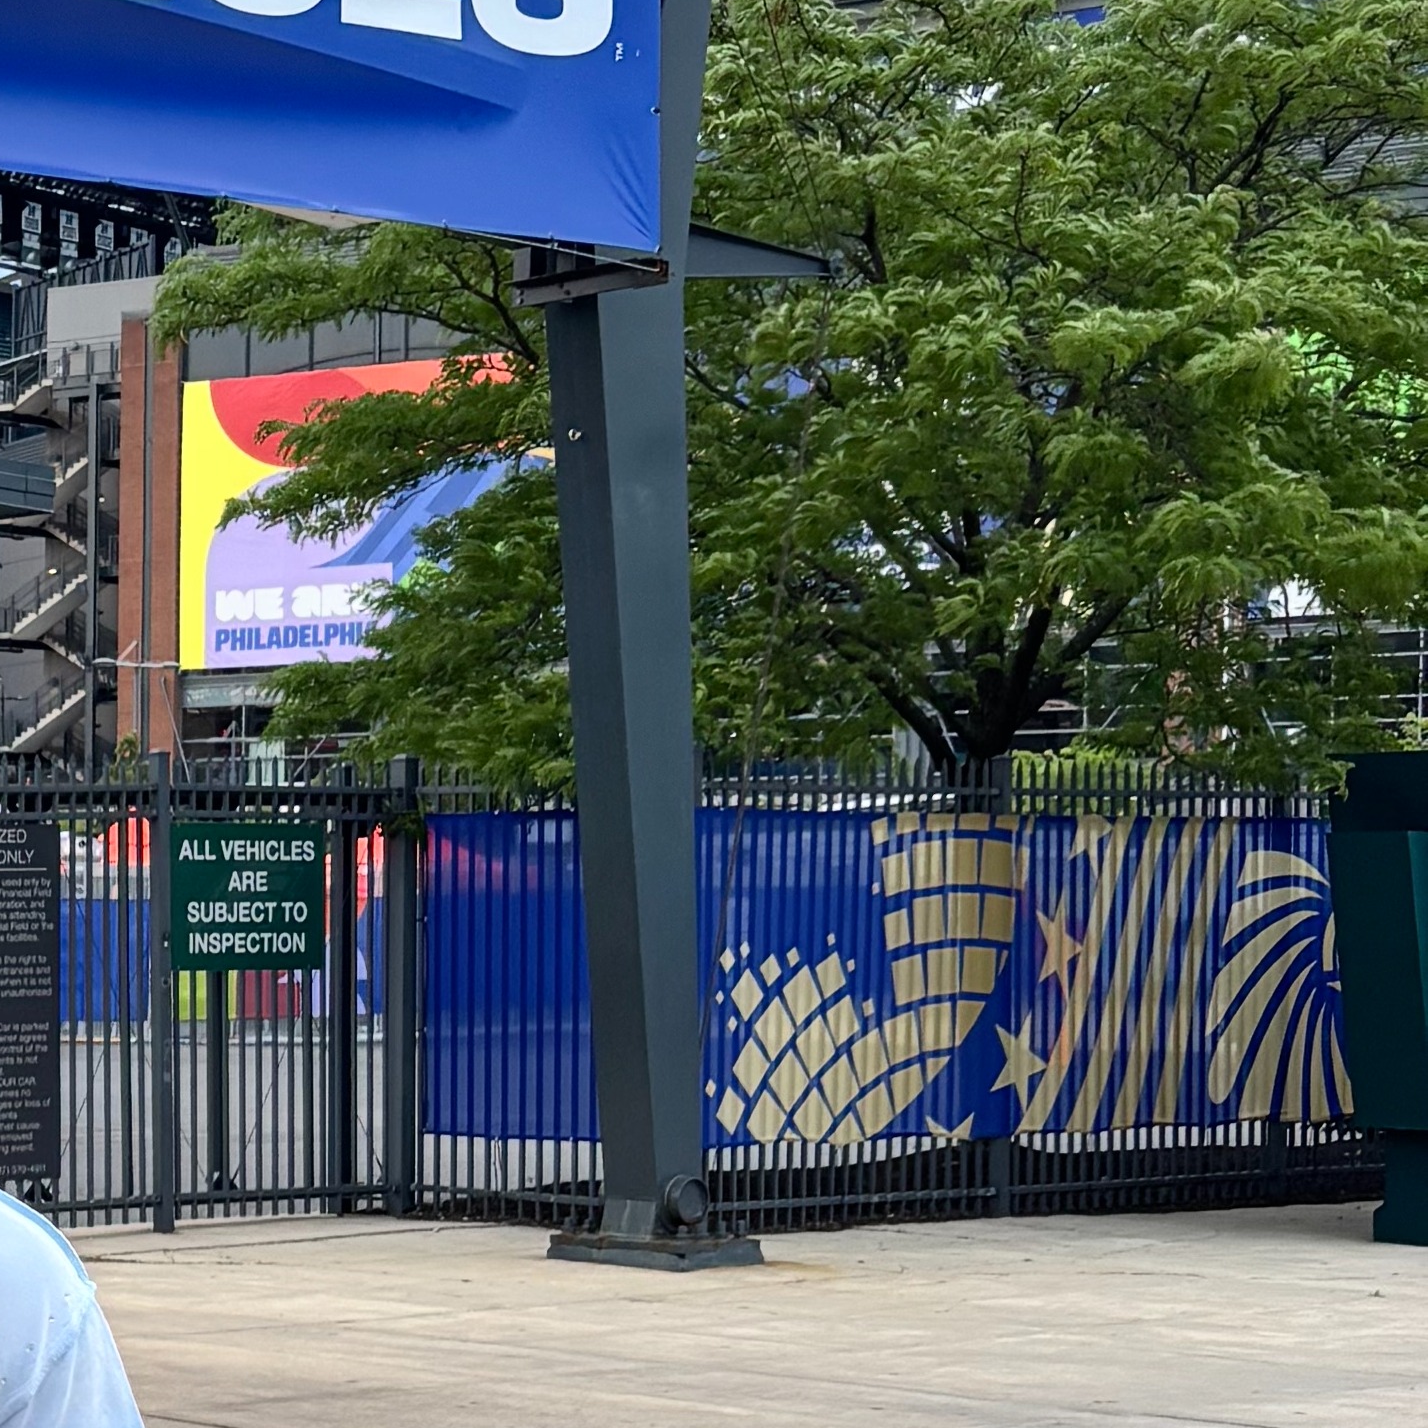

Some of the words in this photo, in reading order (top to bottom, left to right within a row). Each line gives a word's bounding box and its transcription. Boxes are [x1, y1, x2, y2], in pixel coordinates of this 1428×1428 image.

[215, 586, 284, 622] WE
[179, 839, 216, 861] ALL
[221, 840, 315, 861] VEHICLES
[228, 871, 268, 892] ARE
[187, 901, 277, 923] SUBJECT
[281, 901, 308, 922] TO
[189, 932, 305, 954] INSPECTION
